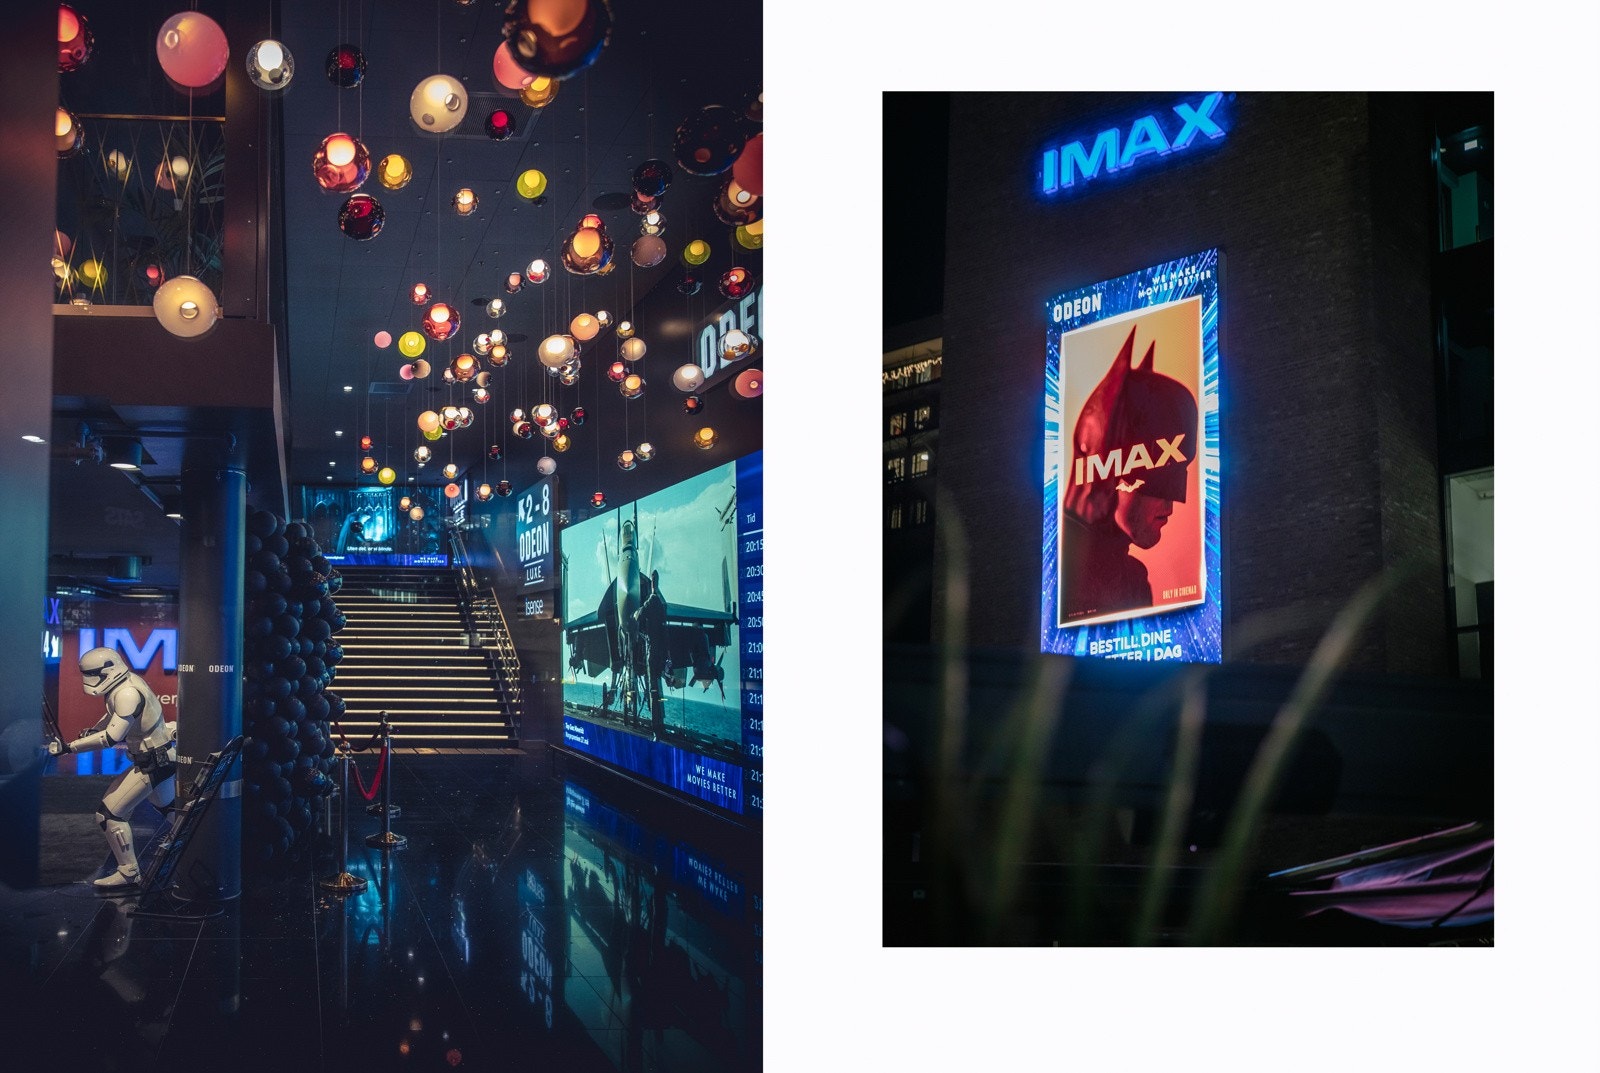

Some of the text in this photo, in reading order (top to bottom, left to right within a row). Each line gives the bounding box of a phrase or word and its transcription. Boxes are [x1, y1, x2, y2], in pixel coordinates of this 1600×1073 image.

[1043, 91, 1226, 194] IMAX
[1138, 270, 1211, 299] MOVIES BETTER
[1152, 265, 1196, 285] WE MAKE
[1053, 293, 1102, 323] ODEON
[1076, 433, 1187, 486] IMAX
[747, 513, 756, 524] Tid
[519, 521, 549, 562] ODEON
[526, 565, 542, 581] LUXE
[1090, 629, 1171, 655] BESTILL DINE
[1154, 644, 1182, 661] DAG
[209, 664, 234, 673] ODEON
[687, 773, 737, 800] MOVIES BETTER
[696, 764, 725, 783] WE MAKE
